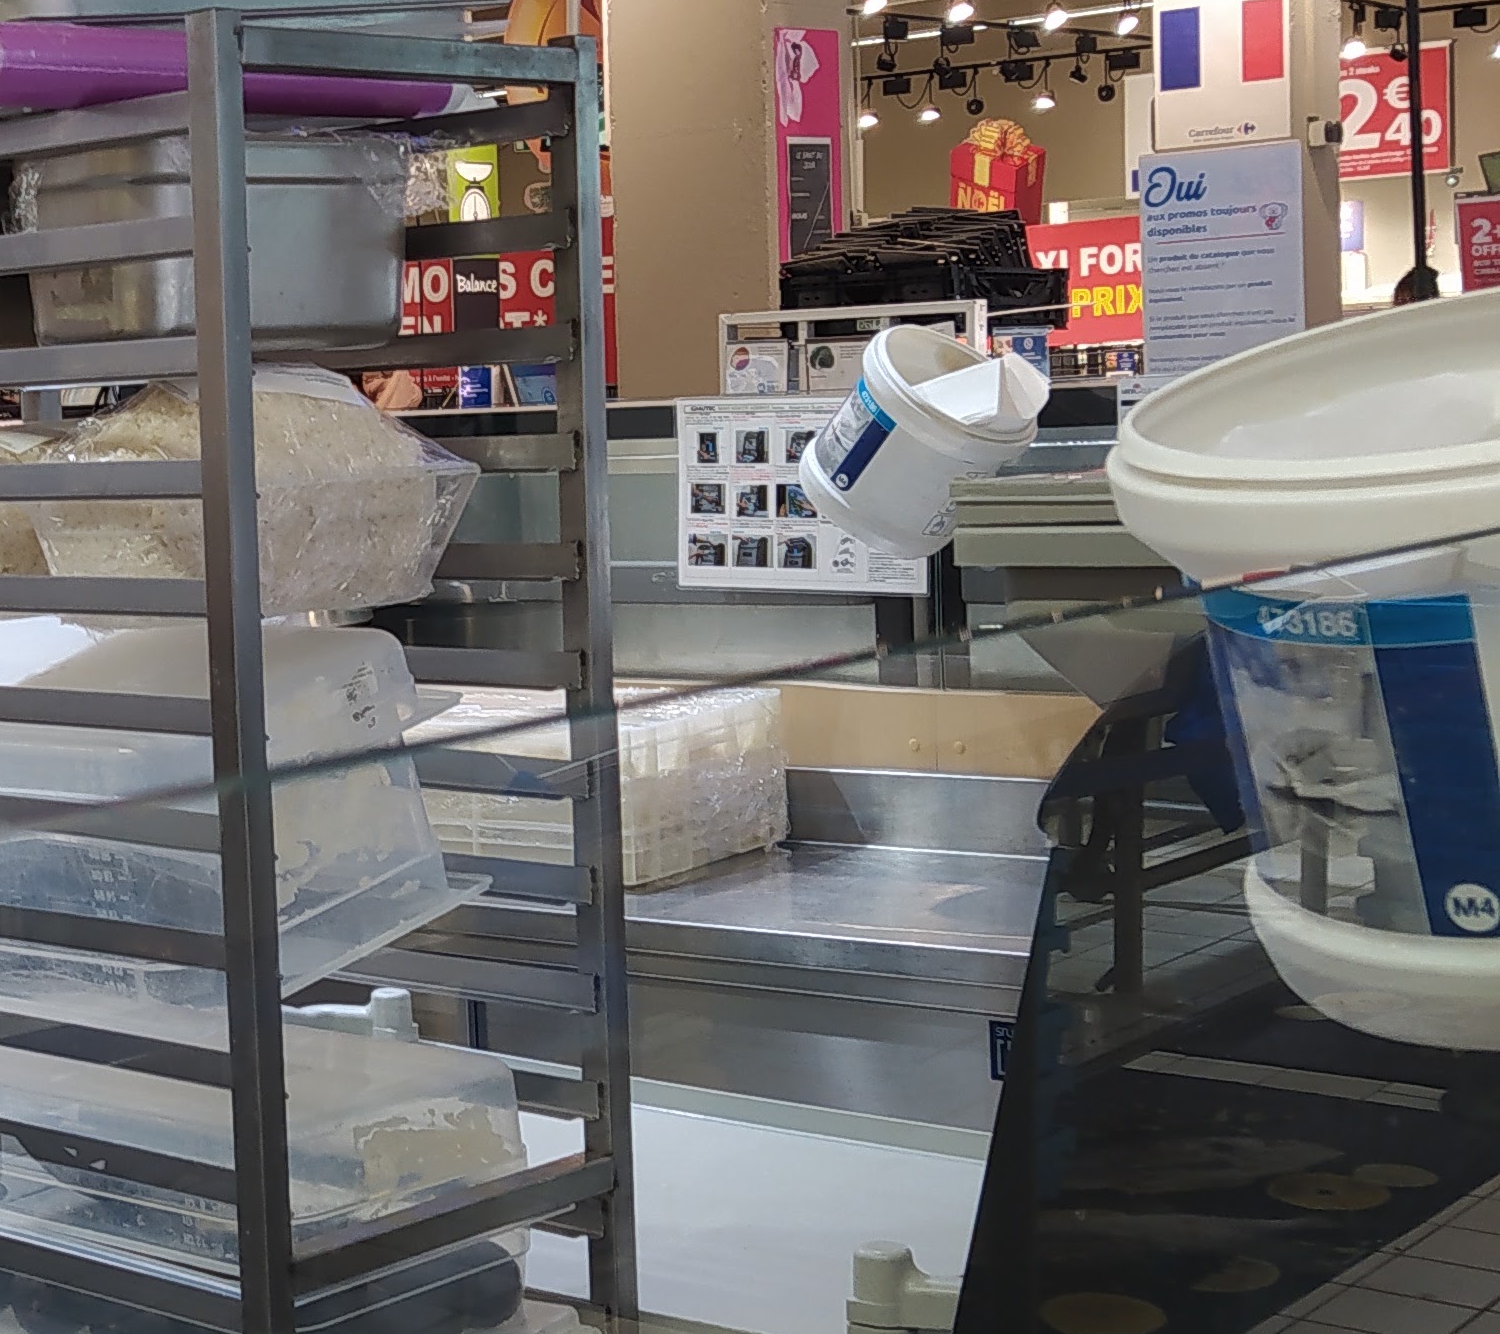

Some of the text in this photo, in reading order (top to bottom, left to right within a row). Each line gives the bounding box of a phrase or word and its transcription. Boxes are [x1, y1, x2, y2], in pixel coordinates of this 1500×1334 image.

[1188, 126, 1234, 138] Carrefour
[1144, 167, 1207, 208] Oui
[1147, 204, 1257, 222] aux promos toujours
[1147, 224, 1208, 238] disponibles
[455, 273, 498, 293] Balance
[1451, 894, 1498, 919] M4
